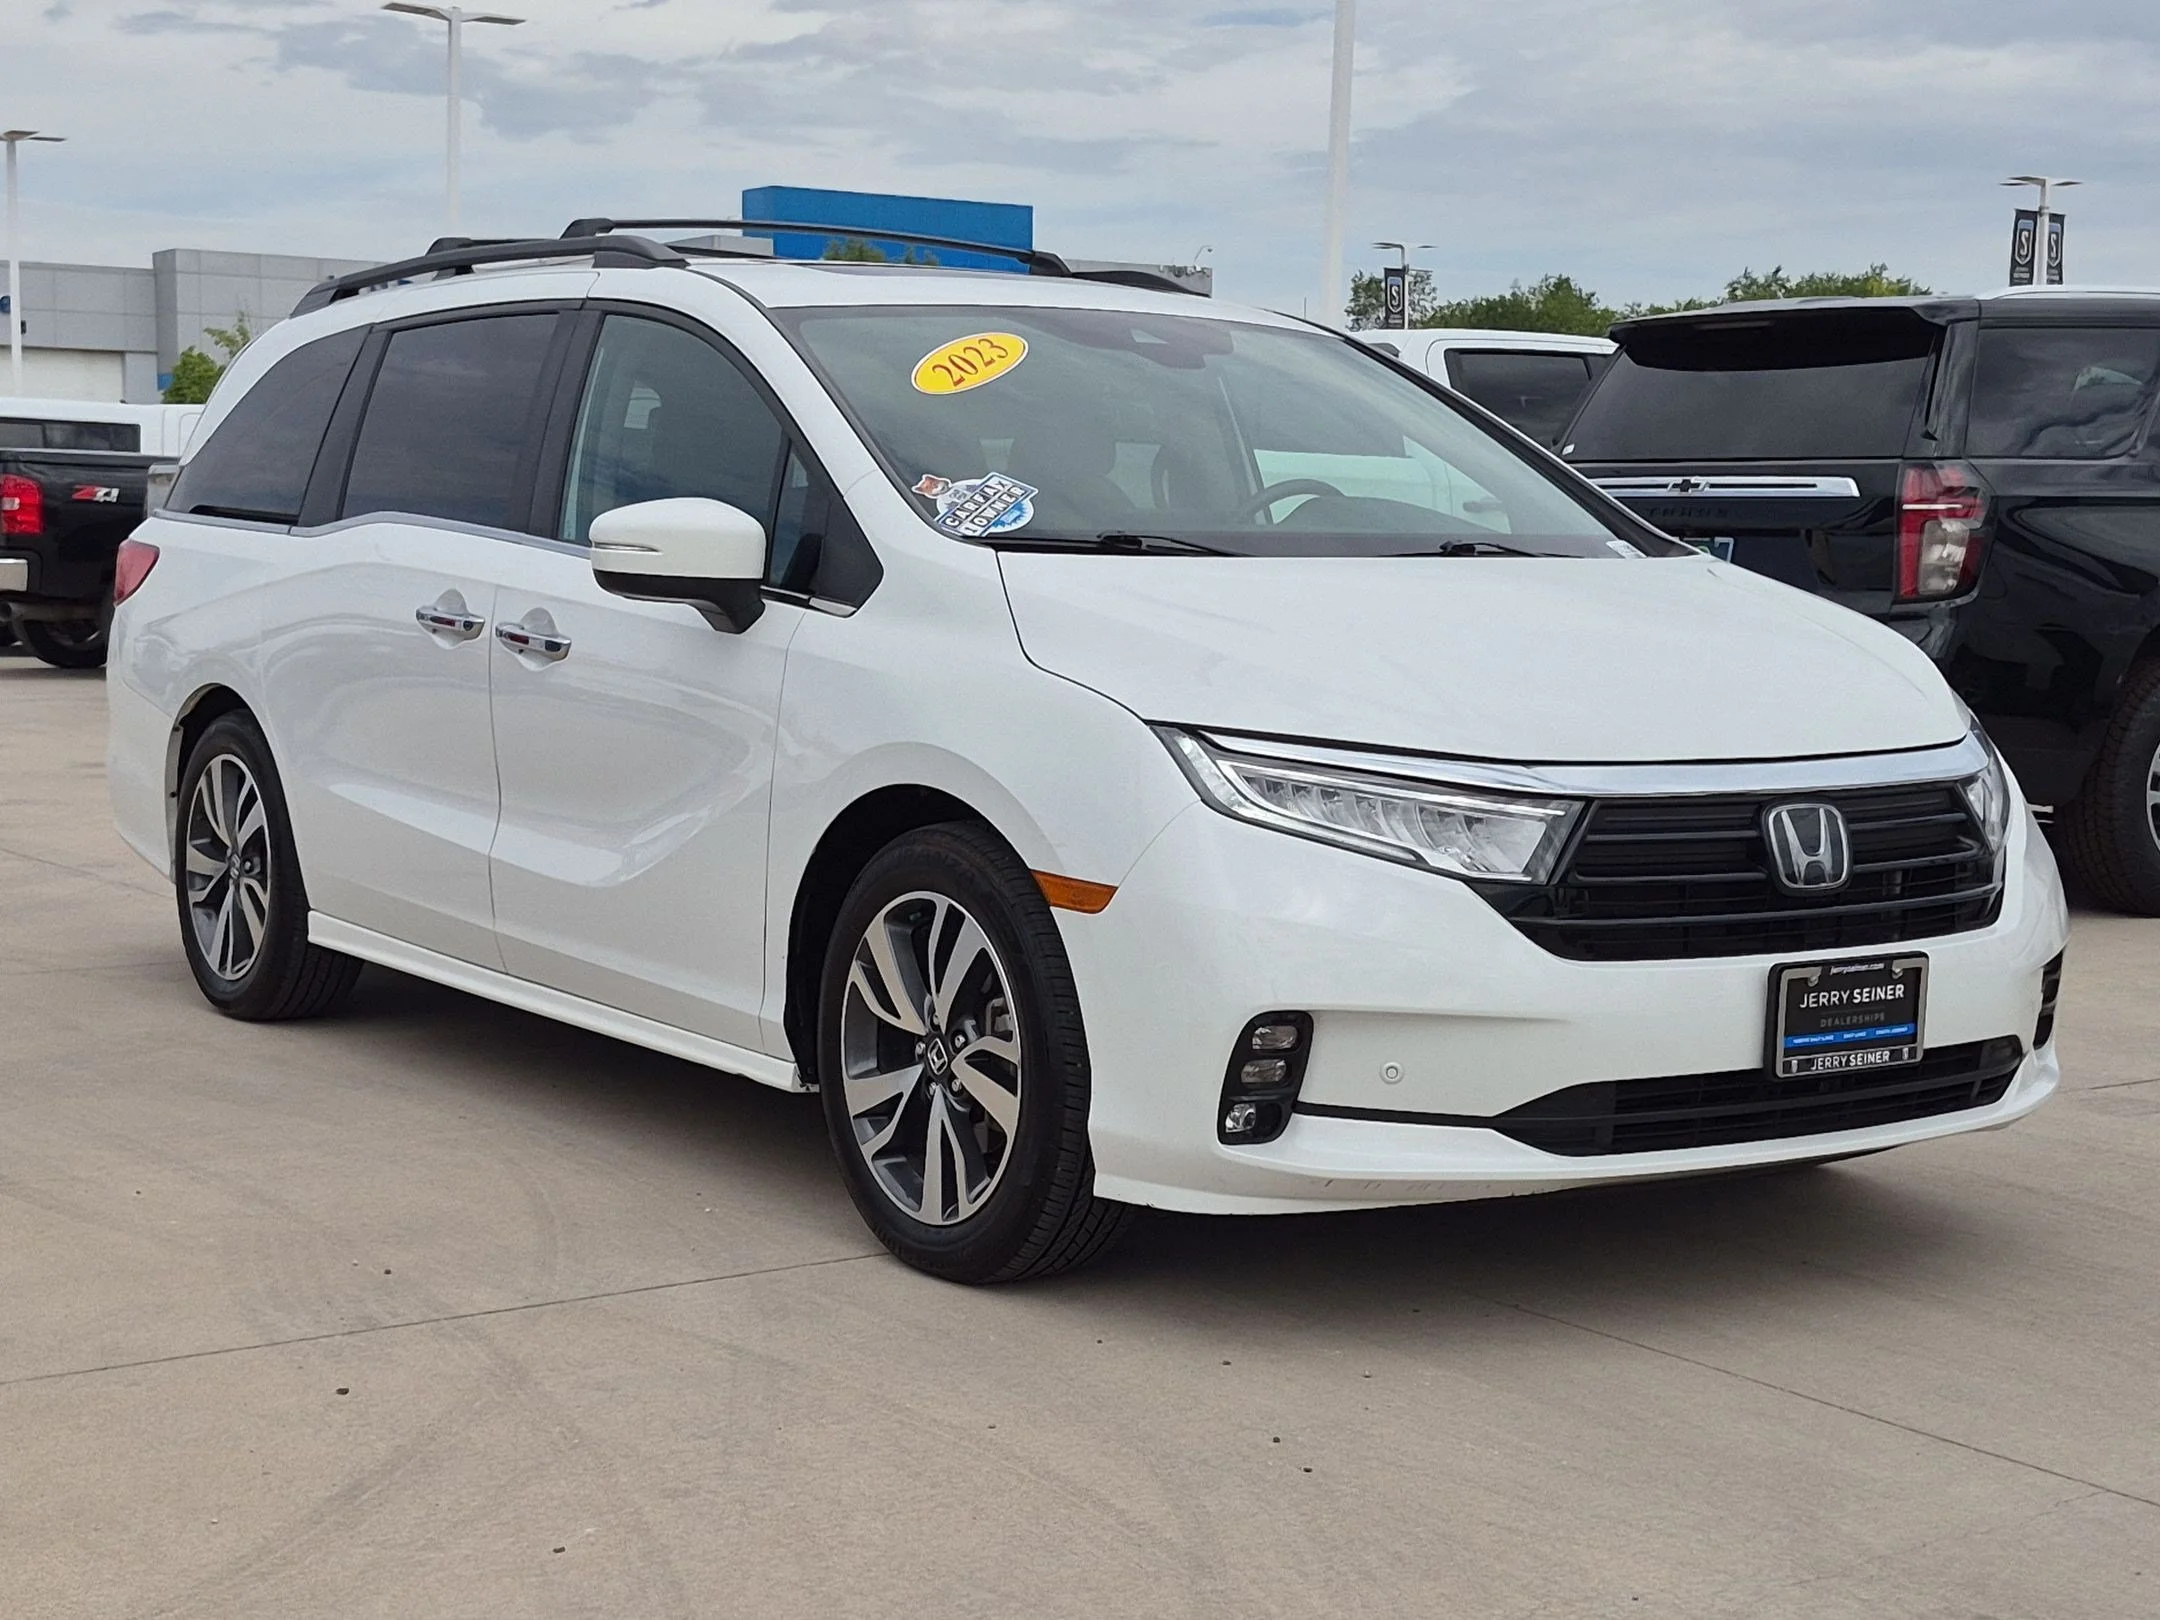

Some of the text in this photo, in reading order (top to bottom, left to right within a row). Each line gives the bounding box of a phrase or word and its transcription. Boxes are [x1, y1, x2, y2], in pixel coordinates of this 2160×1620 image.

[932, 338, 1009, 388] 2023
[944, 480, 1007, 527] CARFAX
[972, 485, 1027, 527] OWNER
[1799, 983, 1905, 1009] JERRY SEINER
[1820, 1011, 1885, 1028] DEALERSHIPS
[1810, 1050, 1891, 1071] JERRY SEINER
